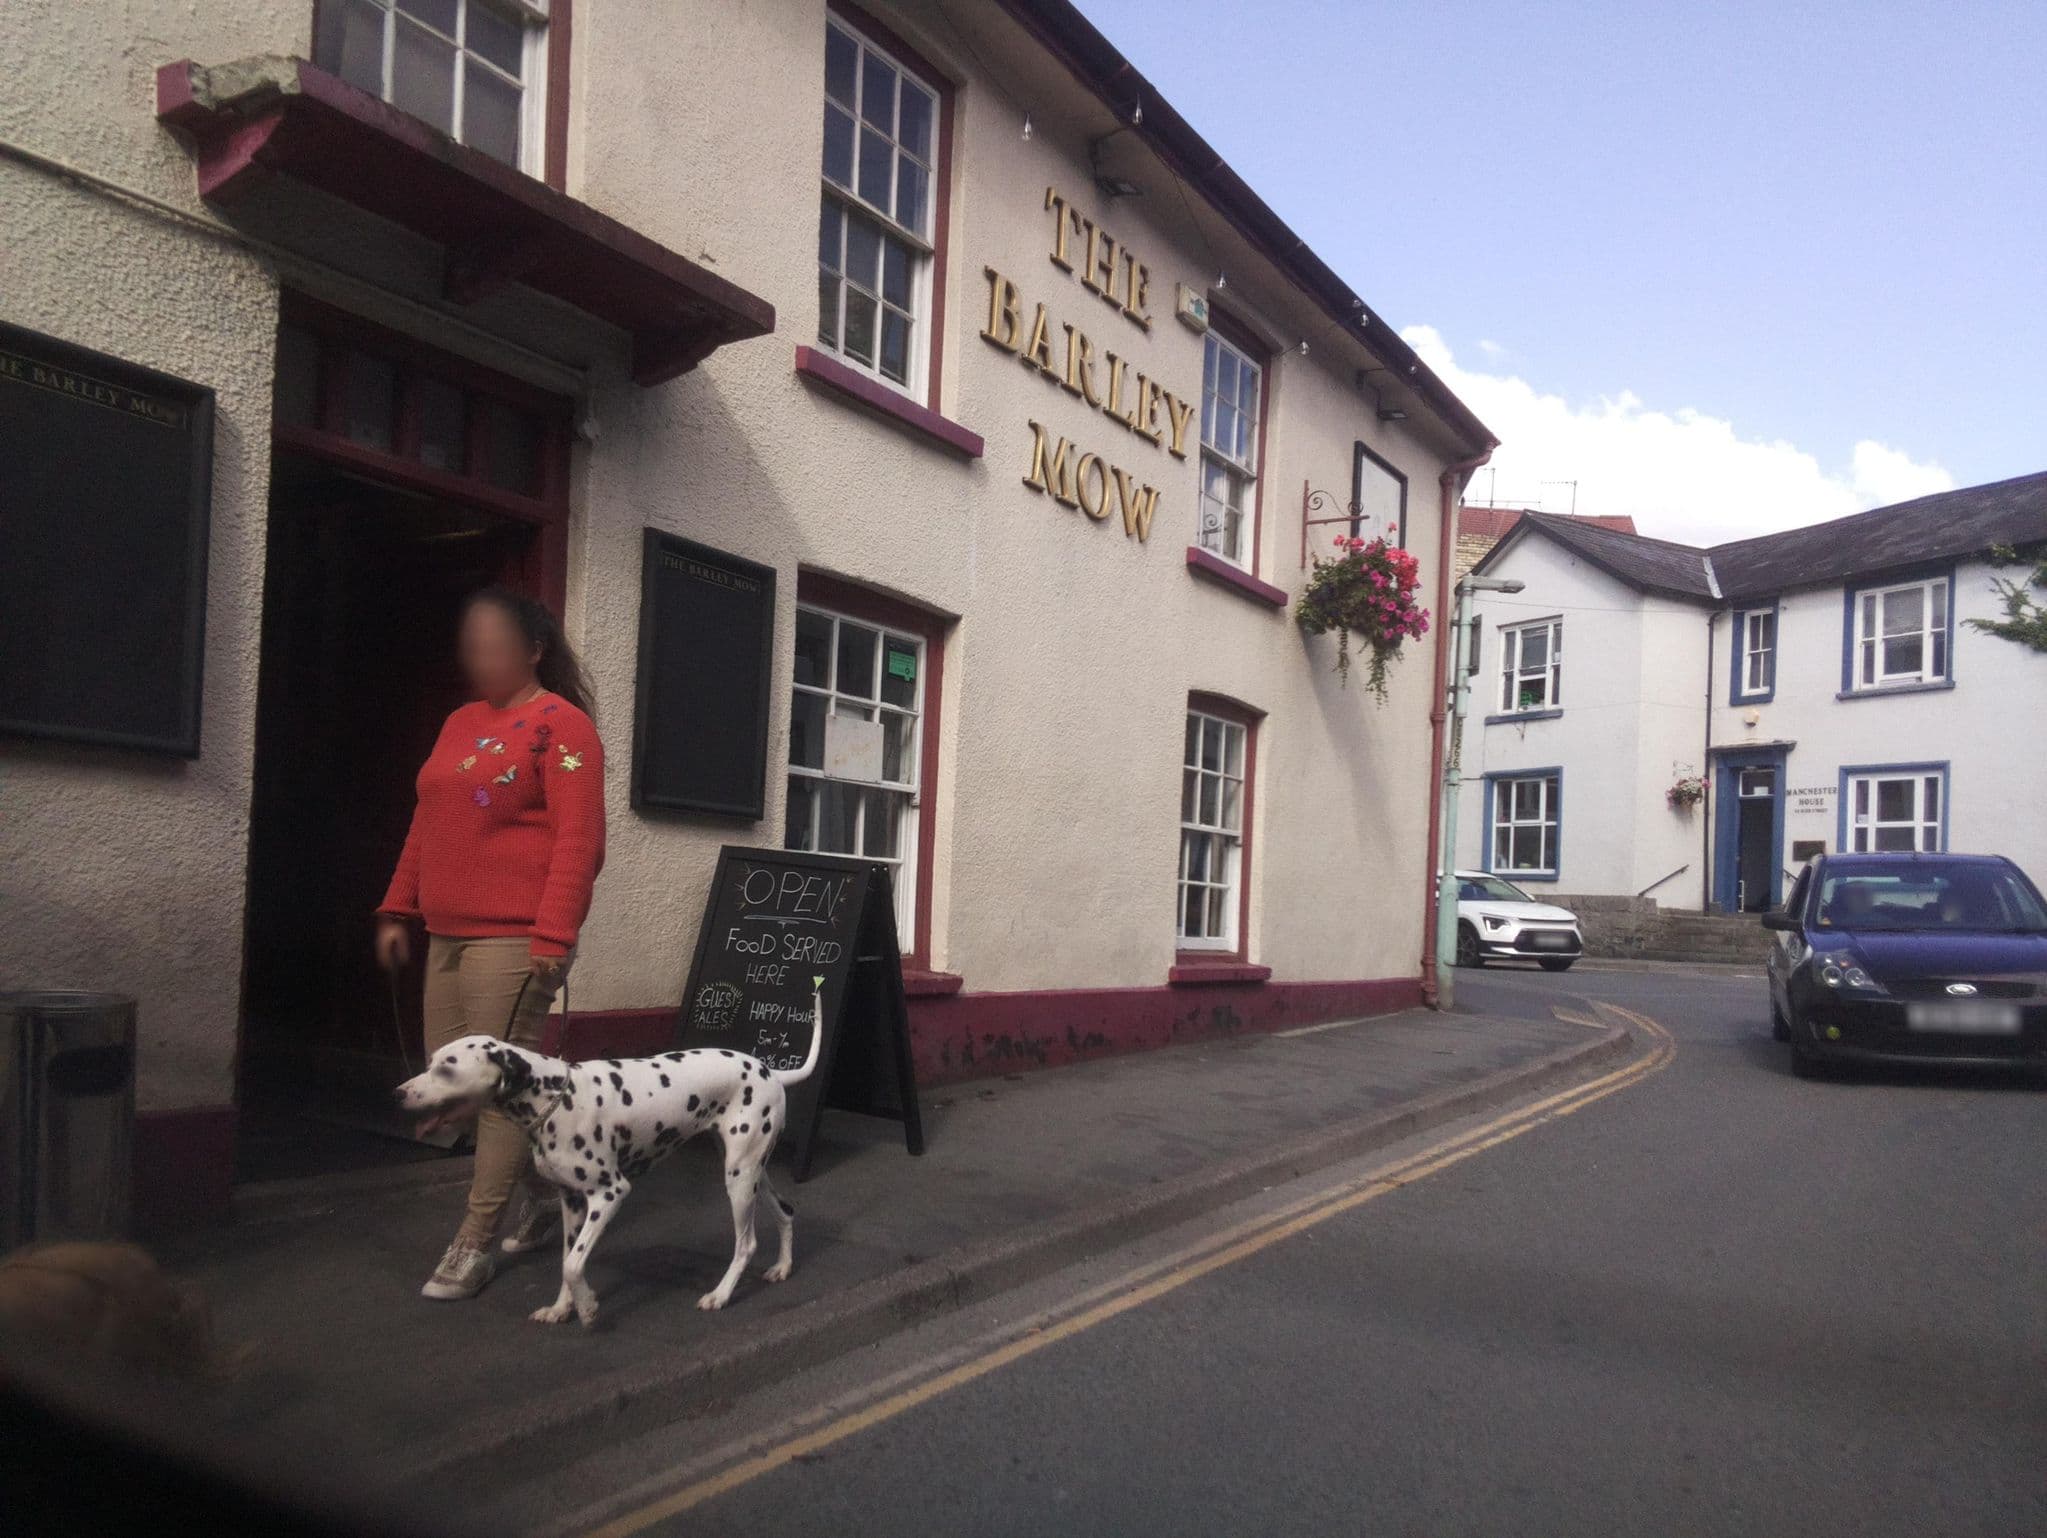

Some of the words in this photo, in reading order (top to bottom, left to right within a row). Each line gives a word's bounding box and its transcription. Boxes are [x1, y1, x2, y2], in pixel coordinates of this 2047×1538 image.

[1044, 186, 1152, 332] THE
[979, 265, 1195, 461] BARLEY
[33, 366, 121, 407] BARLEY
[1022, 418, 1160, 544] MOW
[1786, 787, 1837, 796] MANCHESTER
[1799, 798, 1825, 806] HOUSE
[744, 869, 846, 917] OPEN
[782, 933, 842, 964] SERVED
[745, 962, 790, 985] HERE
[699, 987, 738, 1009] GUEST
[698, 1010, 729, 1025] ALES
[749, 1000, 785, 1024] HAPPY
